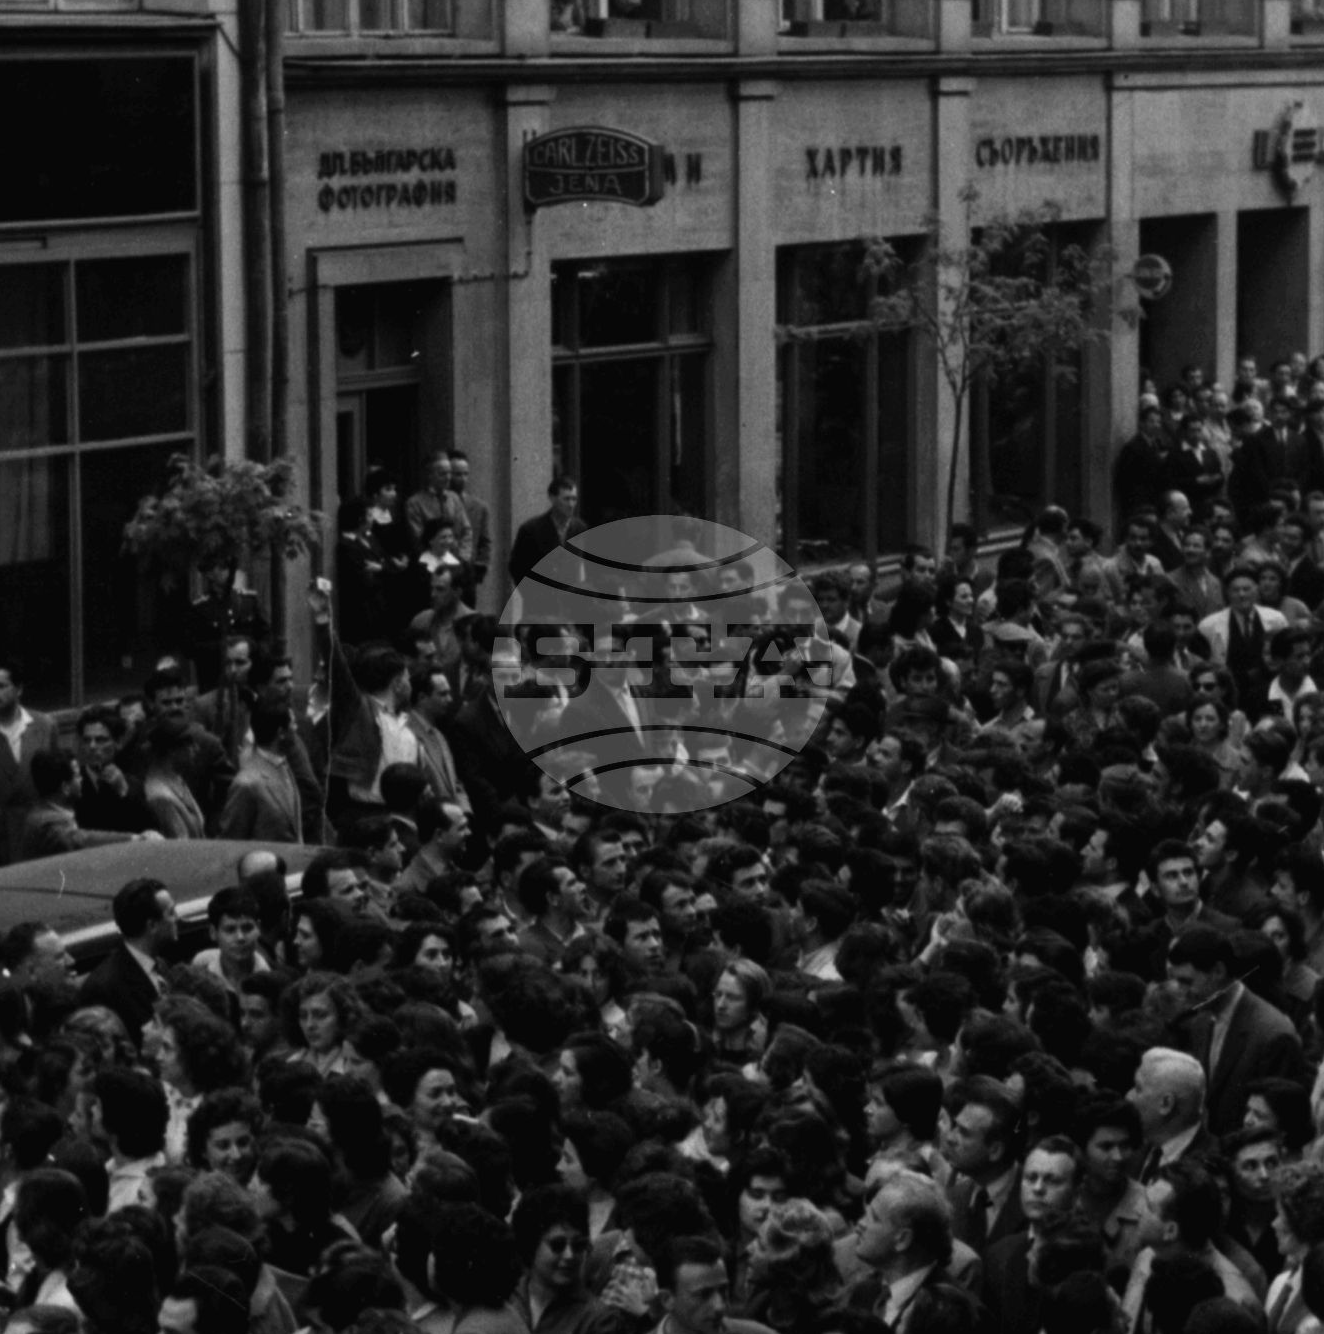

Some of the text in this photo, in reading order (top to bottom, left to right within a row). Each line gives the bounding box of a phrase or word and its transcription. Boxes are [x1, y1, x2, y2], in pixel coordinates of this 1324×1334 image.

[533, 134, 640, 166] CARL ZEISS
[805, 145, 902, 179] ХАРТИЯ
[318, 180, 457, 212] ФОТОГРАФИЯ
[548, 174, 622, 195] JENA
